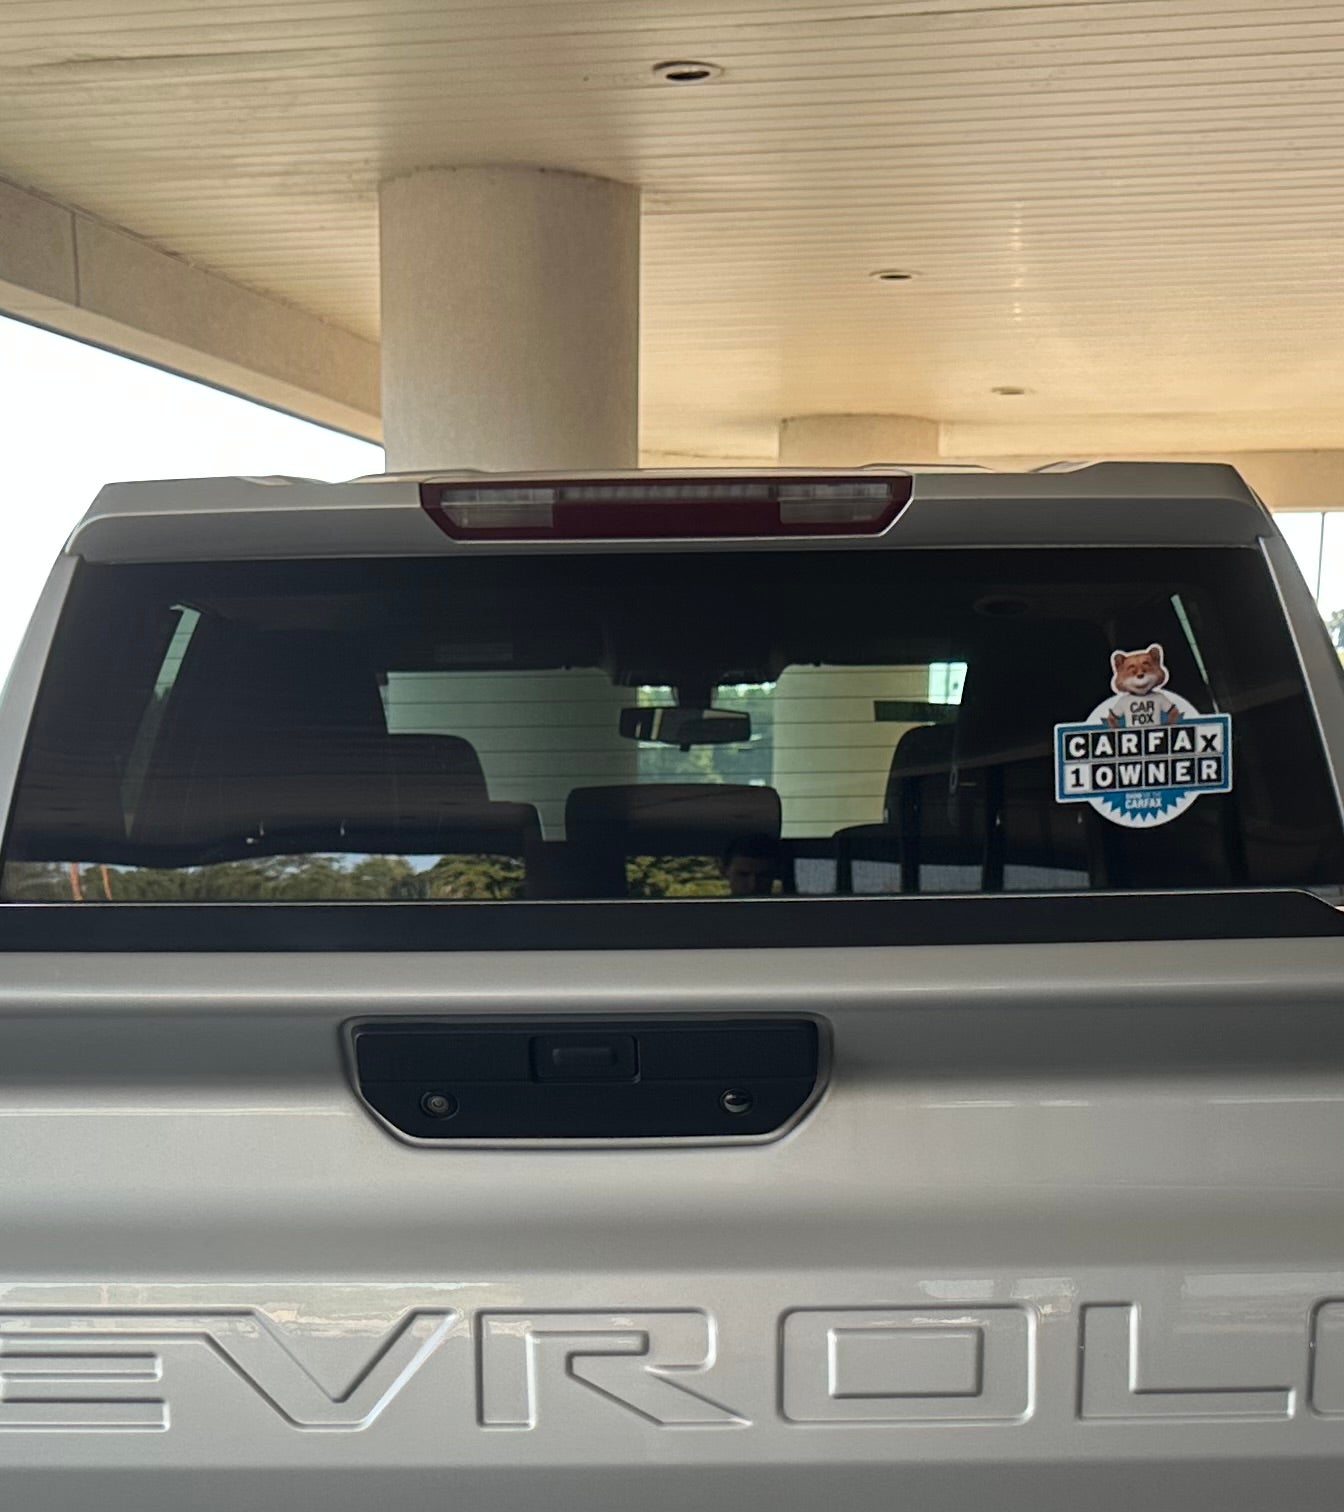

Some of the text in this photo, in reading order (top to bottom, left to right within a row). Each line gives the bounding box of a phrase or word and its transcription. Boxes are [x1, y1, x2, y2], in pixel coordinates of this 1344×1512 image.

[1129, 701, 1155, 713] CAR
[1131, 713, 1154, 725] FOX
[1068, 729, 1218, 758] CARFAX
[1094, 759, 1219, 788] OWNER
